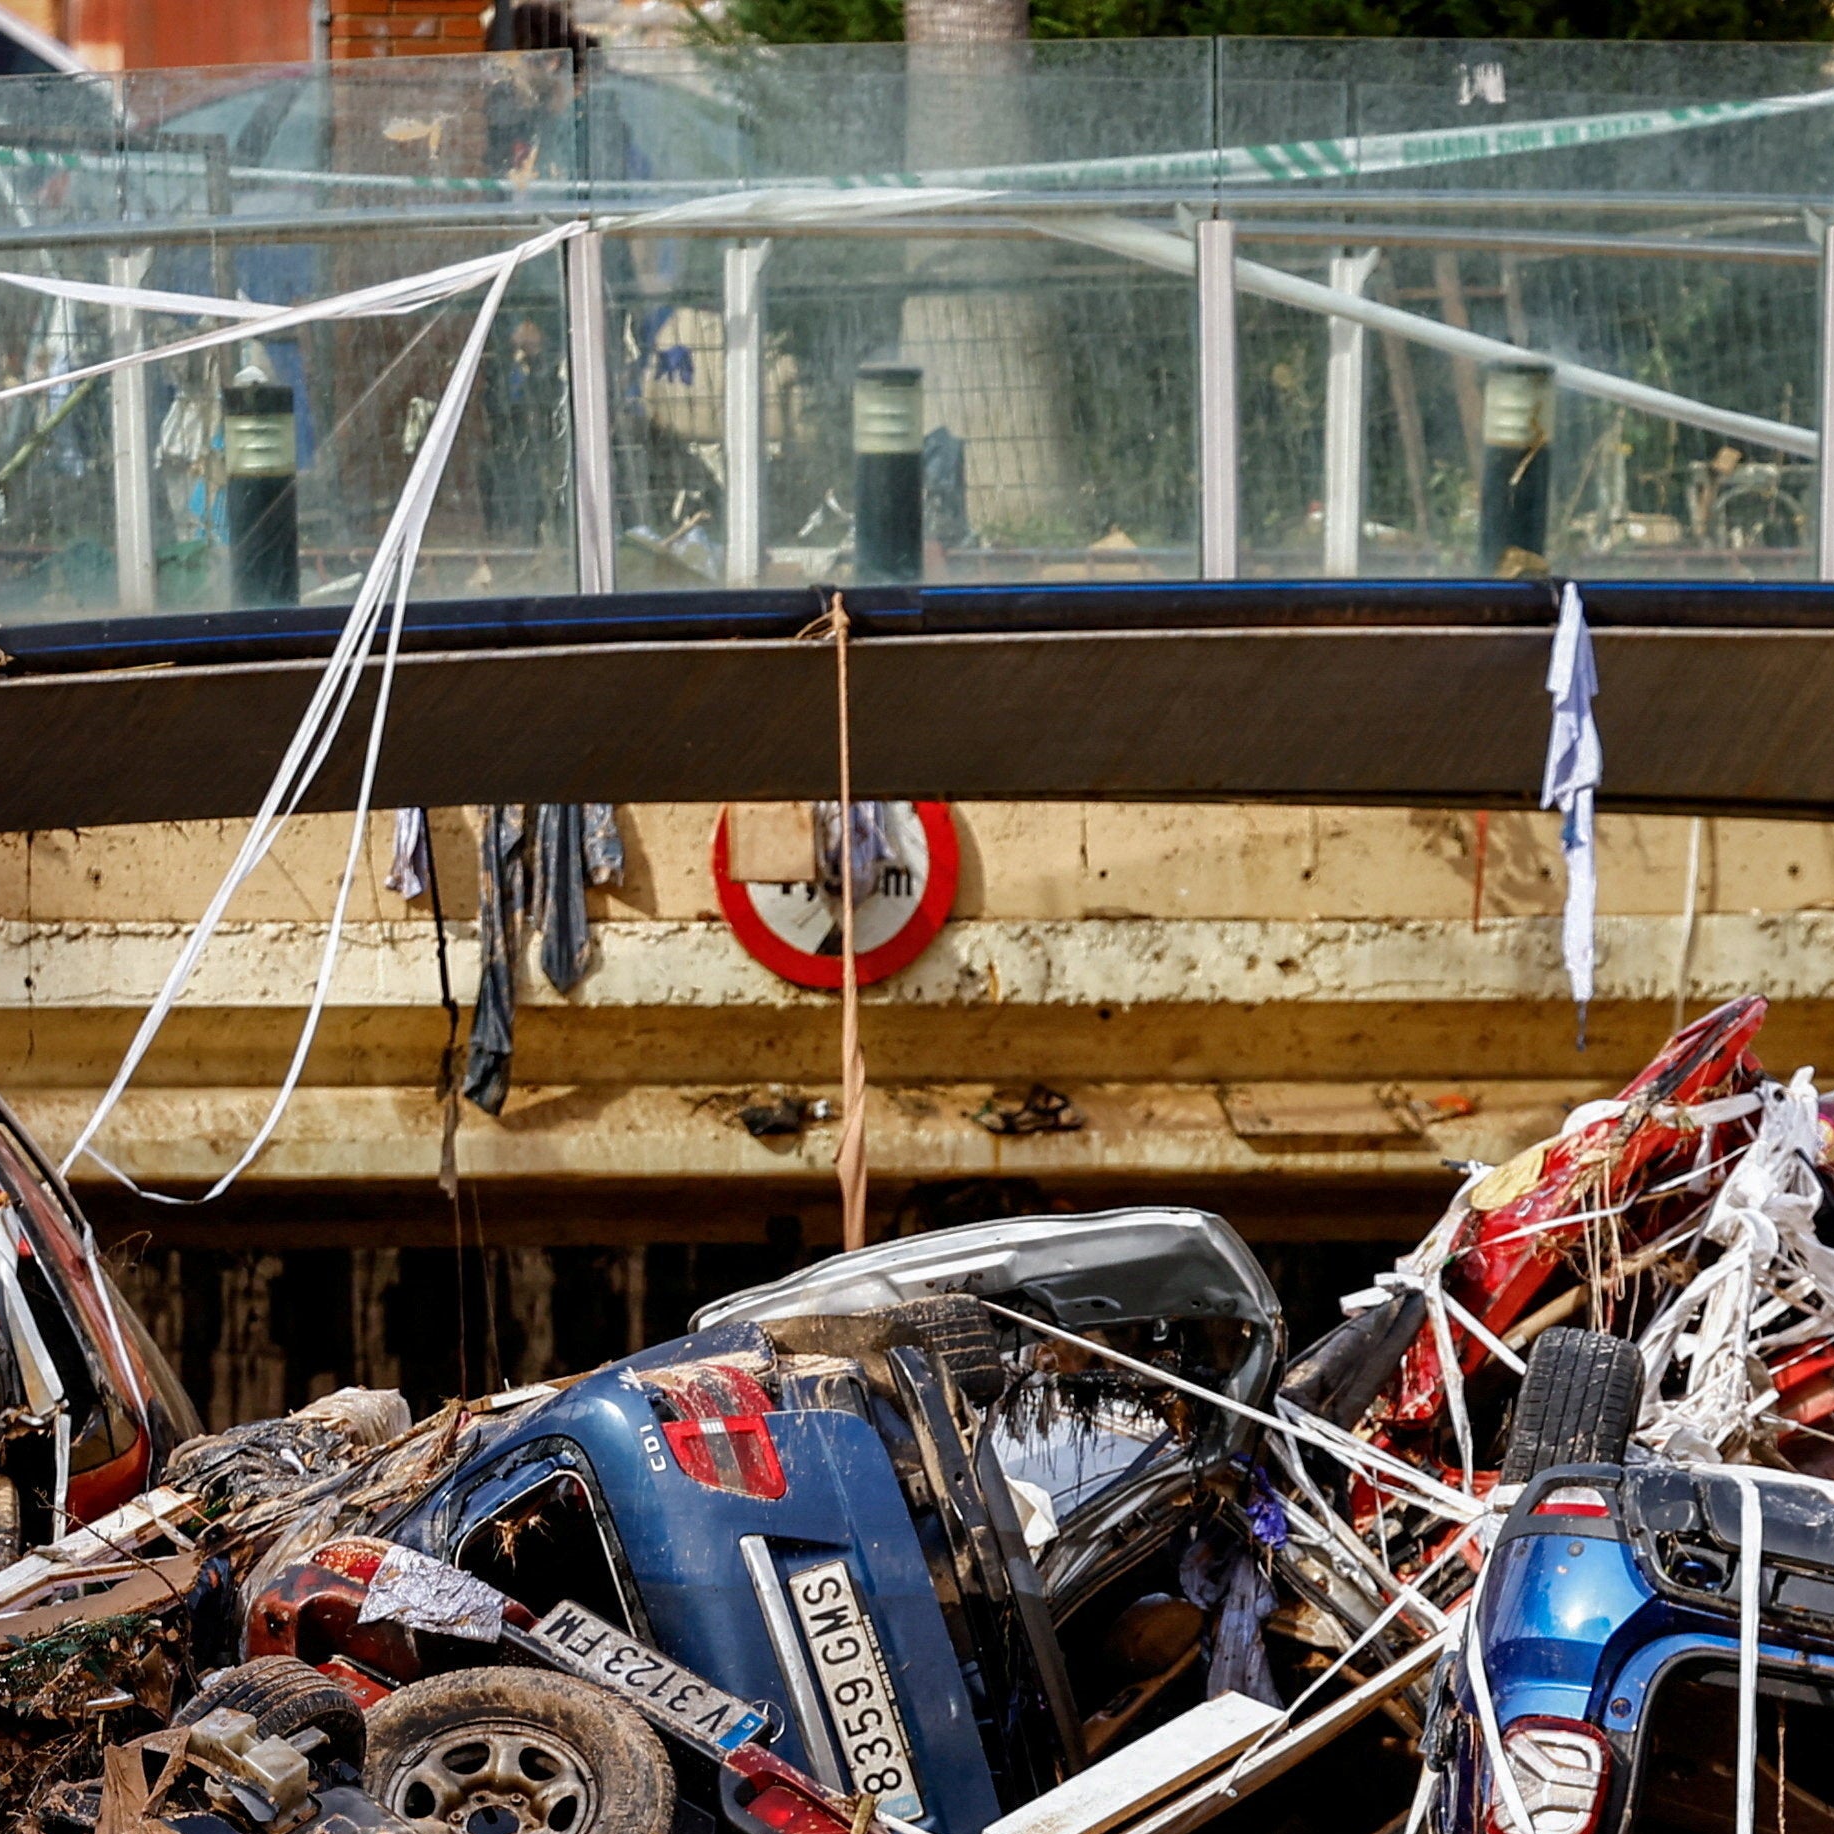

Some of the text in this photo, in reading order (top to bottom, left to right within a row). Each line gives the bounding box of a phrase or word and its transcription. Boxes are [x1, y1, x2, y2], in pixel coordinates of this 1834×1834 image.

[639, 1424, 667, 1472] CDI
[544, 1608, 609, 1658] FM
[603, 1645, 704, 1713] 3123
[802, 1576, 903, 1795] 8359 GMS
[695, 1703, 730, 1733] V
